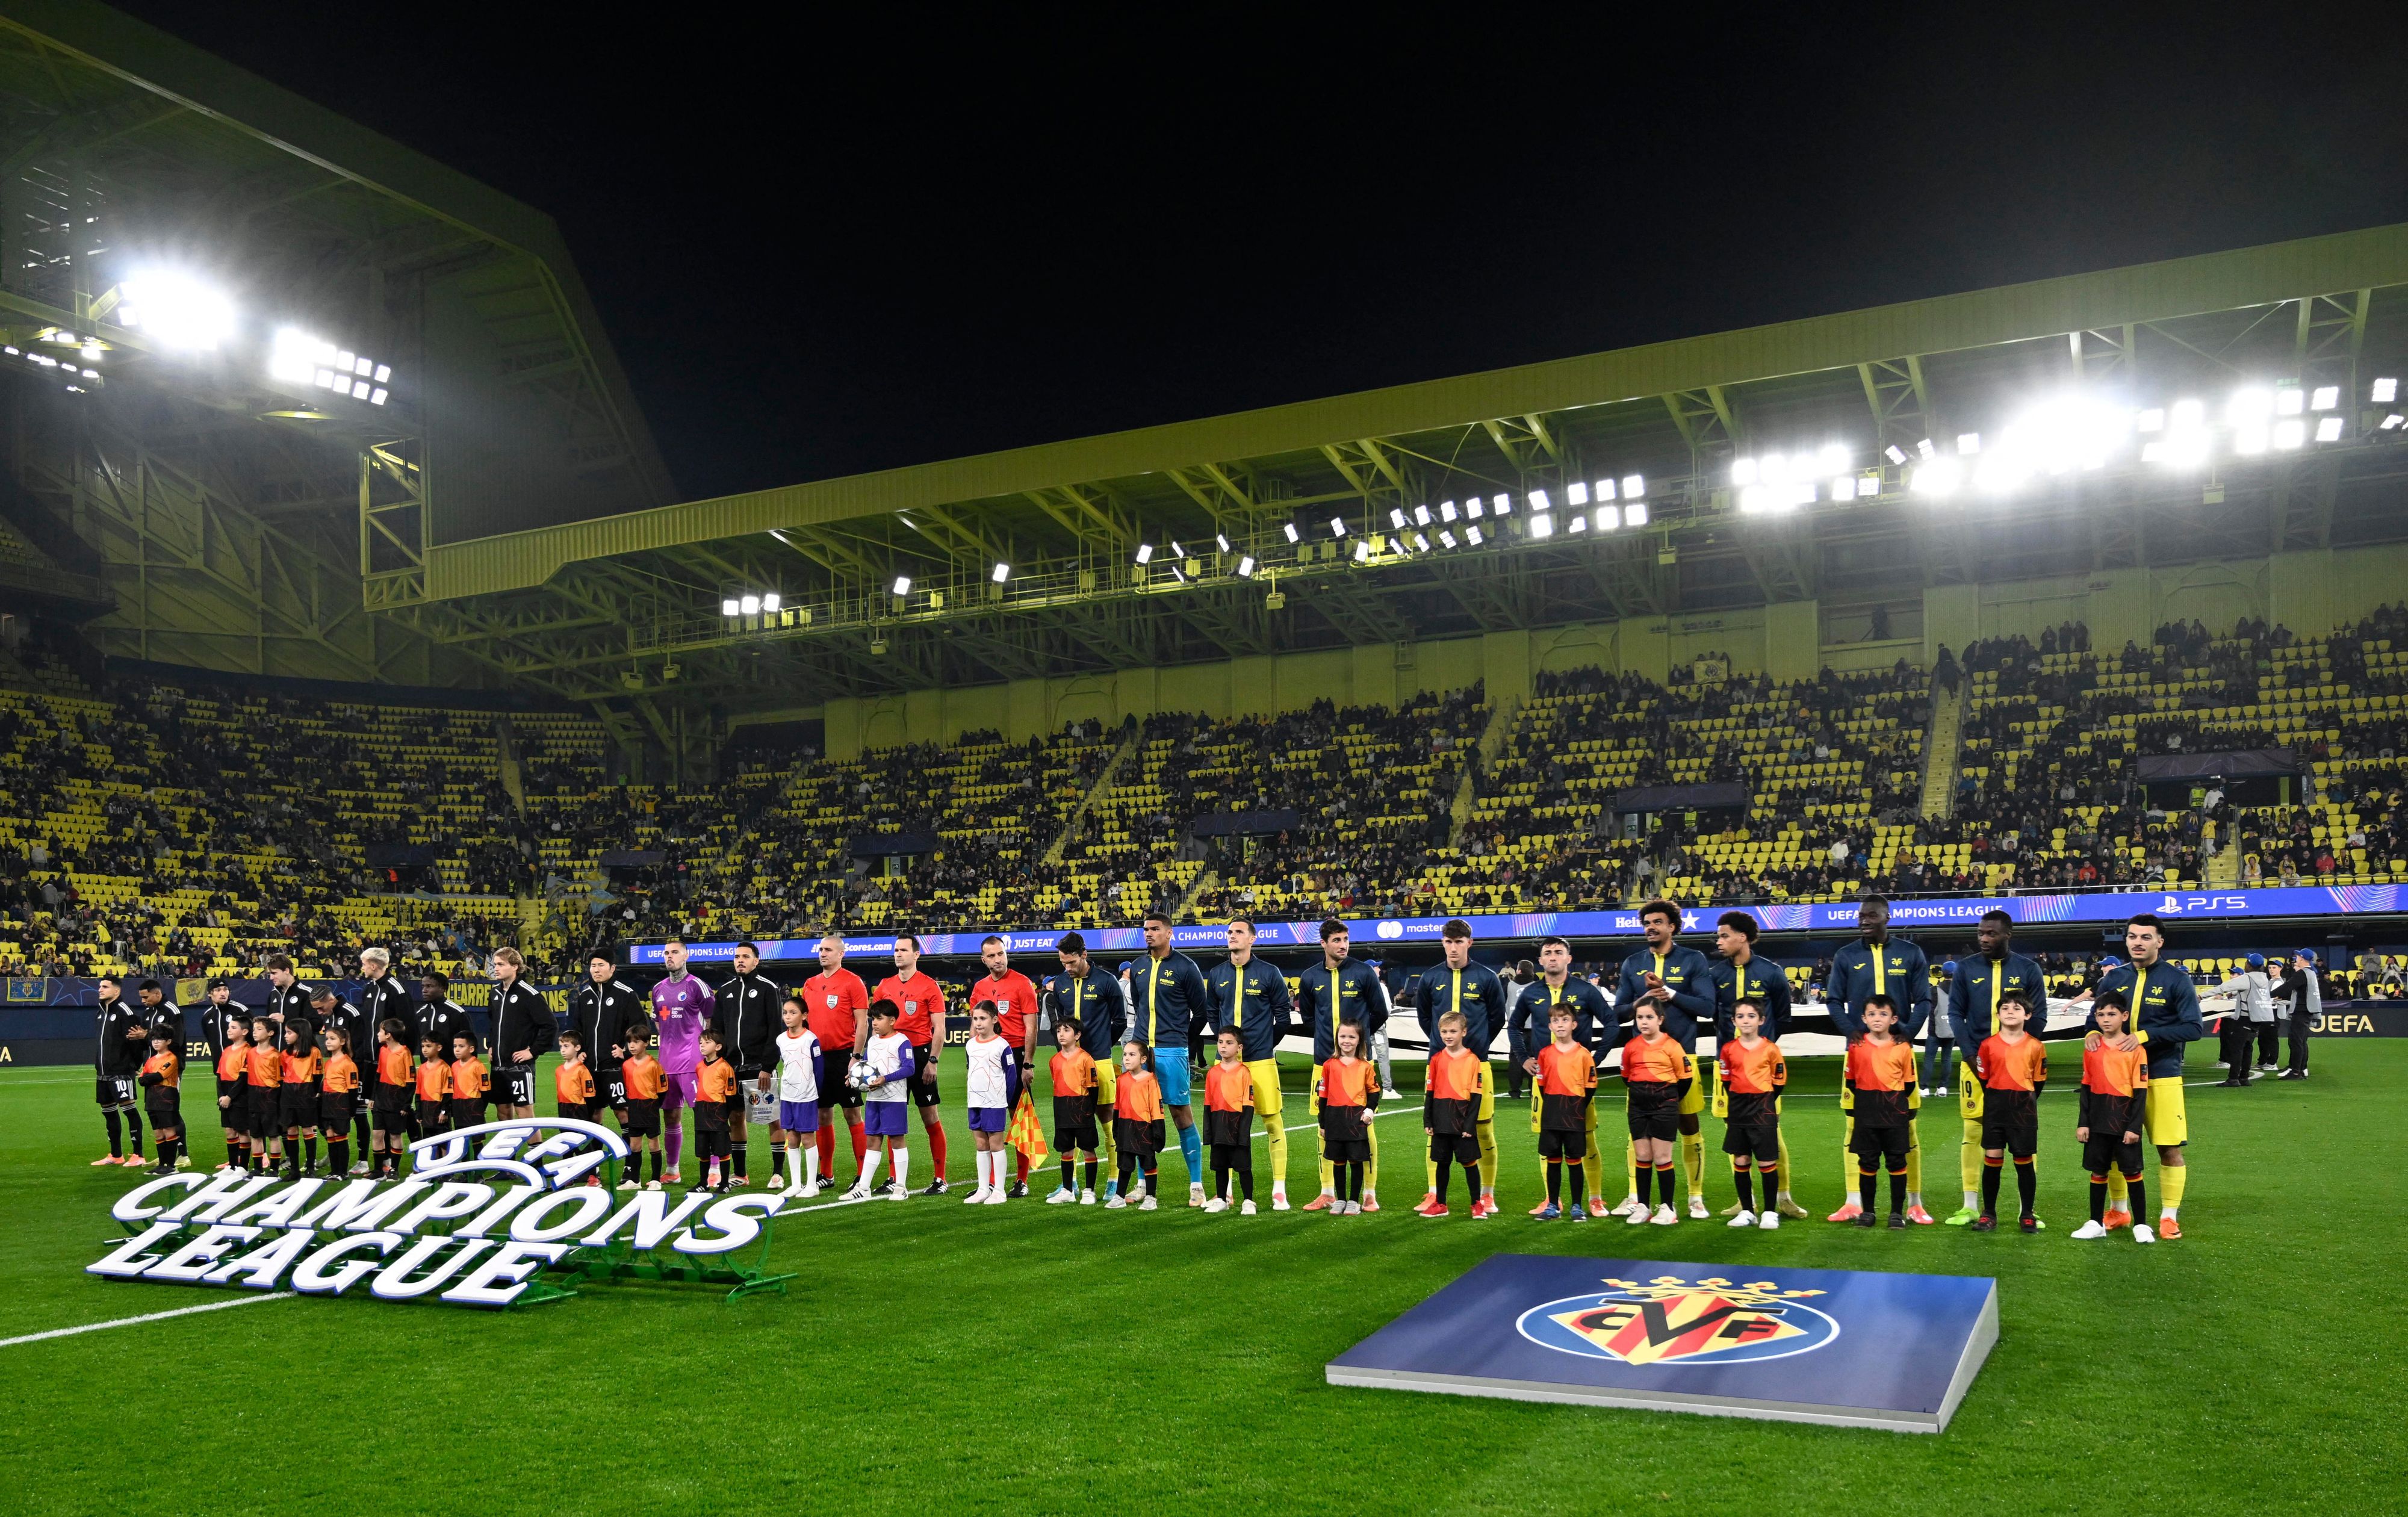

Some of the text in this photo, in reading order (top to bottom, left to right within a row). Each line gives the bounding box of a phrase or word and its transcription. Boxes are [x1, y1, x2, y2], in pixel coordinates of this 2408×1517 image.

[2187, 896, 2246, 910] PS5
[1888, 907, 1945, 919] MPIONS
[1406, 923, 1444, 932] master
[1178, 931, 1228, 941] CHAMPION
[1014, 938, 1054, 949] JUST EAT
[944, 1030, 970, 1044] UEF
[186, 1042, 212, 1056] EFA
[115, 1080, 127, 1092] 10
[512, 1081, 524, 1095] 21
[610, 1082, 624, 1097] 20
[1961, 1080, 1972, 1098] 19
[414, 1127, 607, 1191] UEFA
[110, 1172, 788, 1254] CHAMPIONS
[85, 1221, 569, 1304] LEAGUE
